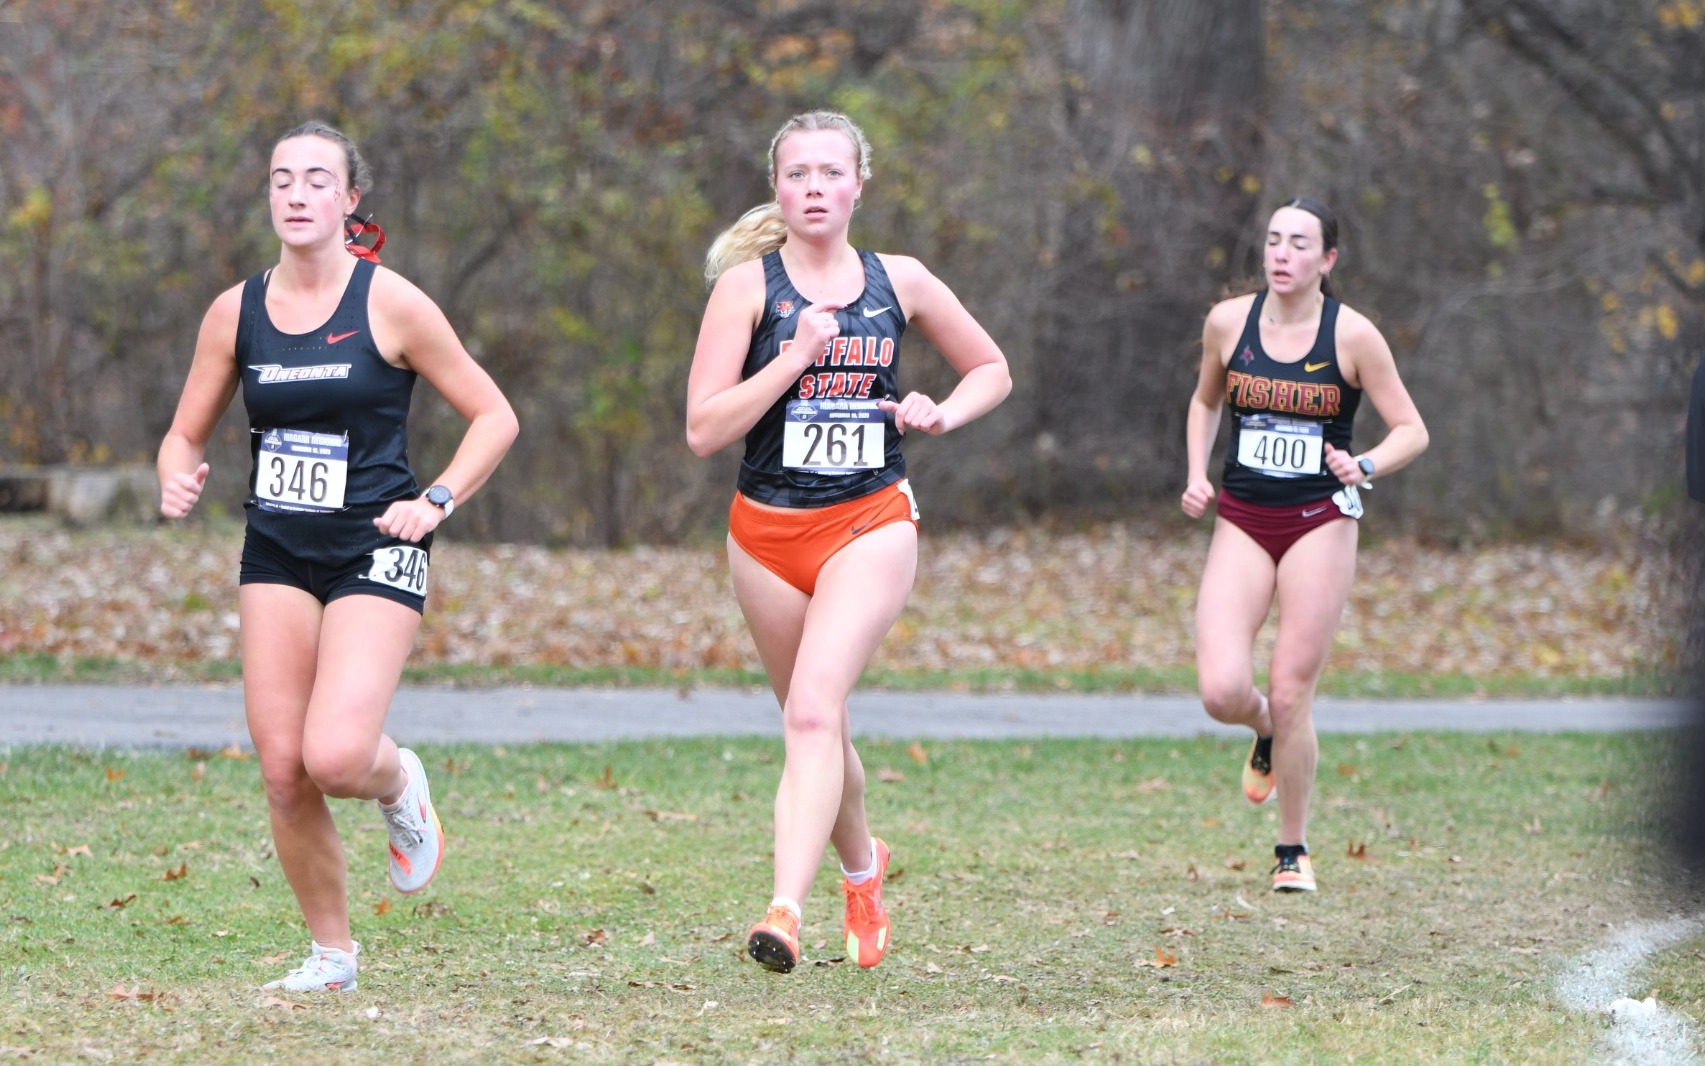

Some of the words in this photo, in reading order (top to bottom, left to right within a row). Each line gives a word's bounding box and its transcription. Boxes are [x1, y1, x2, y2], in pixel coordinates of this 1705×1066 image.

[256, 365, 351, 383] ONEONTA
[798, 372, 877, 399] STATE
[1226, 369, 1341, 417] FISHER
[803, 423, 868, 467] 261
[1253, 435, 1307, 469] 400
[269, 456, 329, 503] 346
[384, 547, 427, 592] 346
